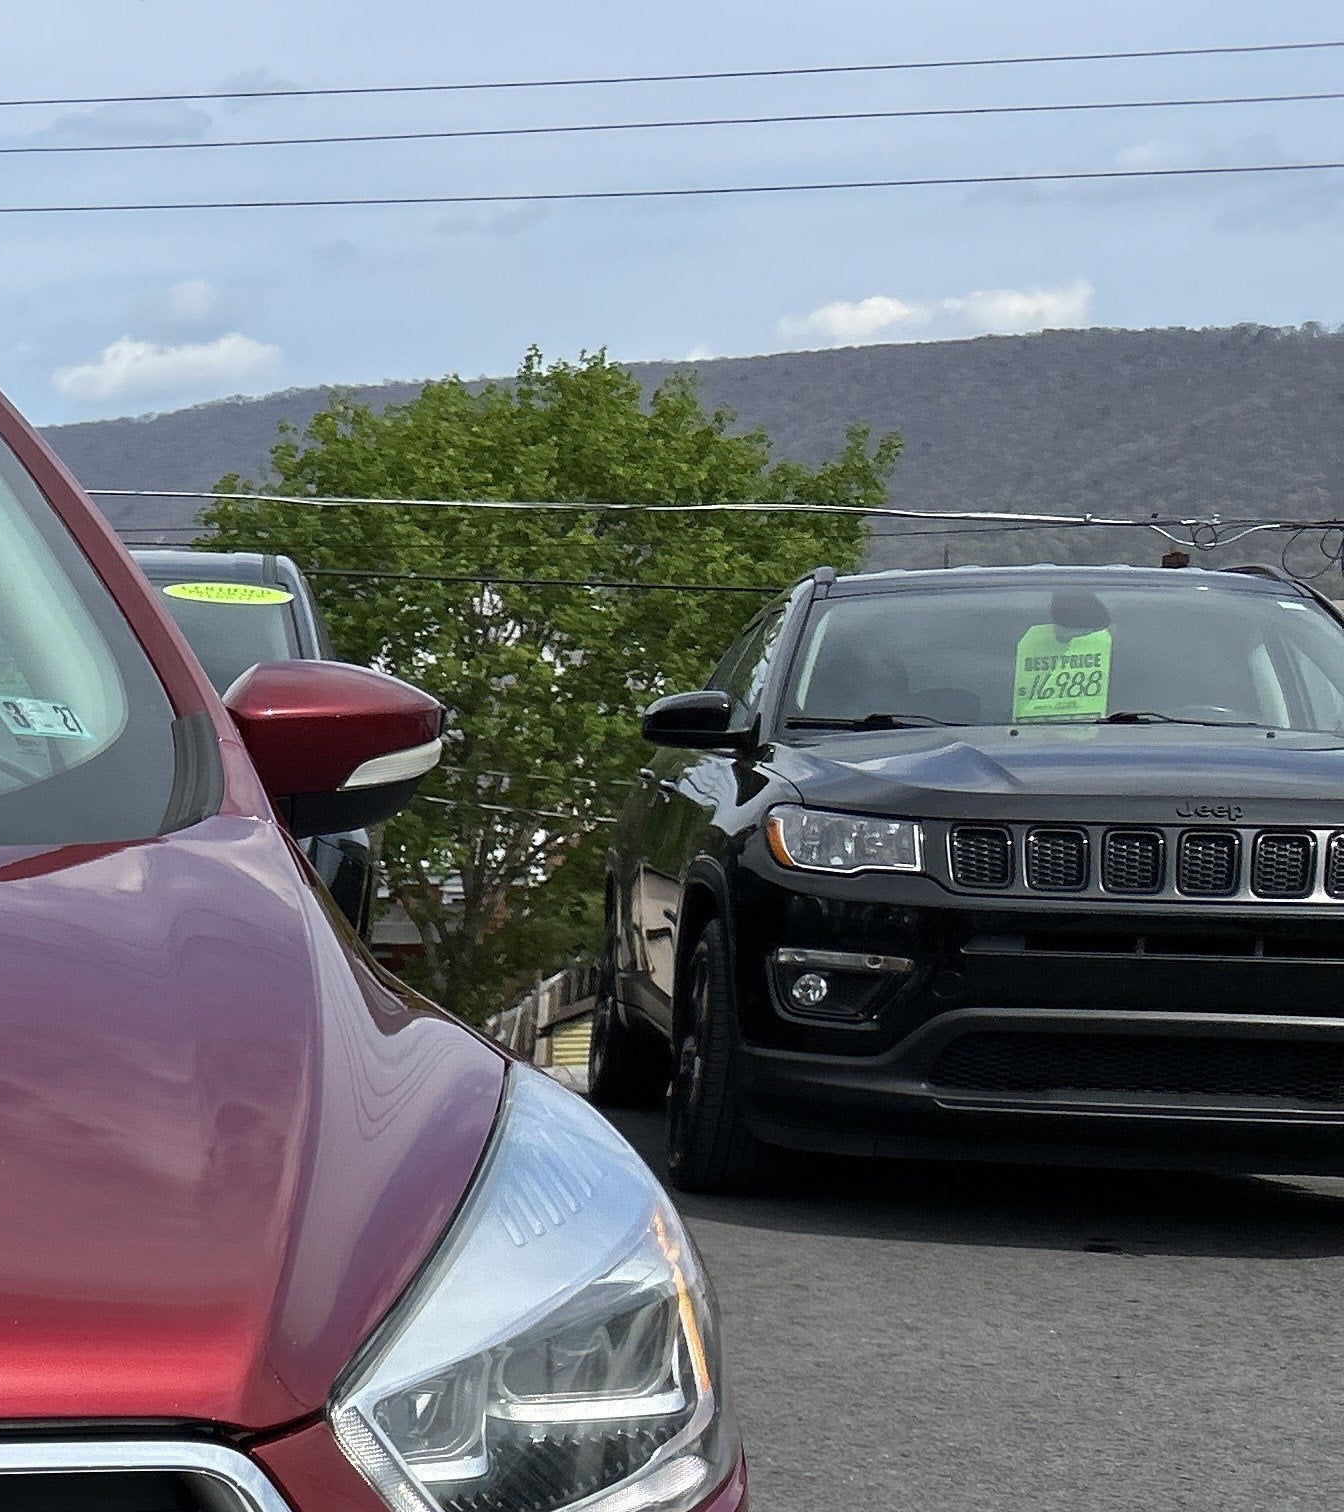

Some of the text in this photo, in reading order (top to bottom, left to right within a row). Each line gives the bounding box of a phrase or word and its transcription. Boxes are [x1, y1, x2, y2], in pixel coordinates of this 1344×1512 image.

[1024, 653, 1102, 672] BEST PRICE
[1176, 801, 1243, 821] Jeep
